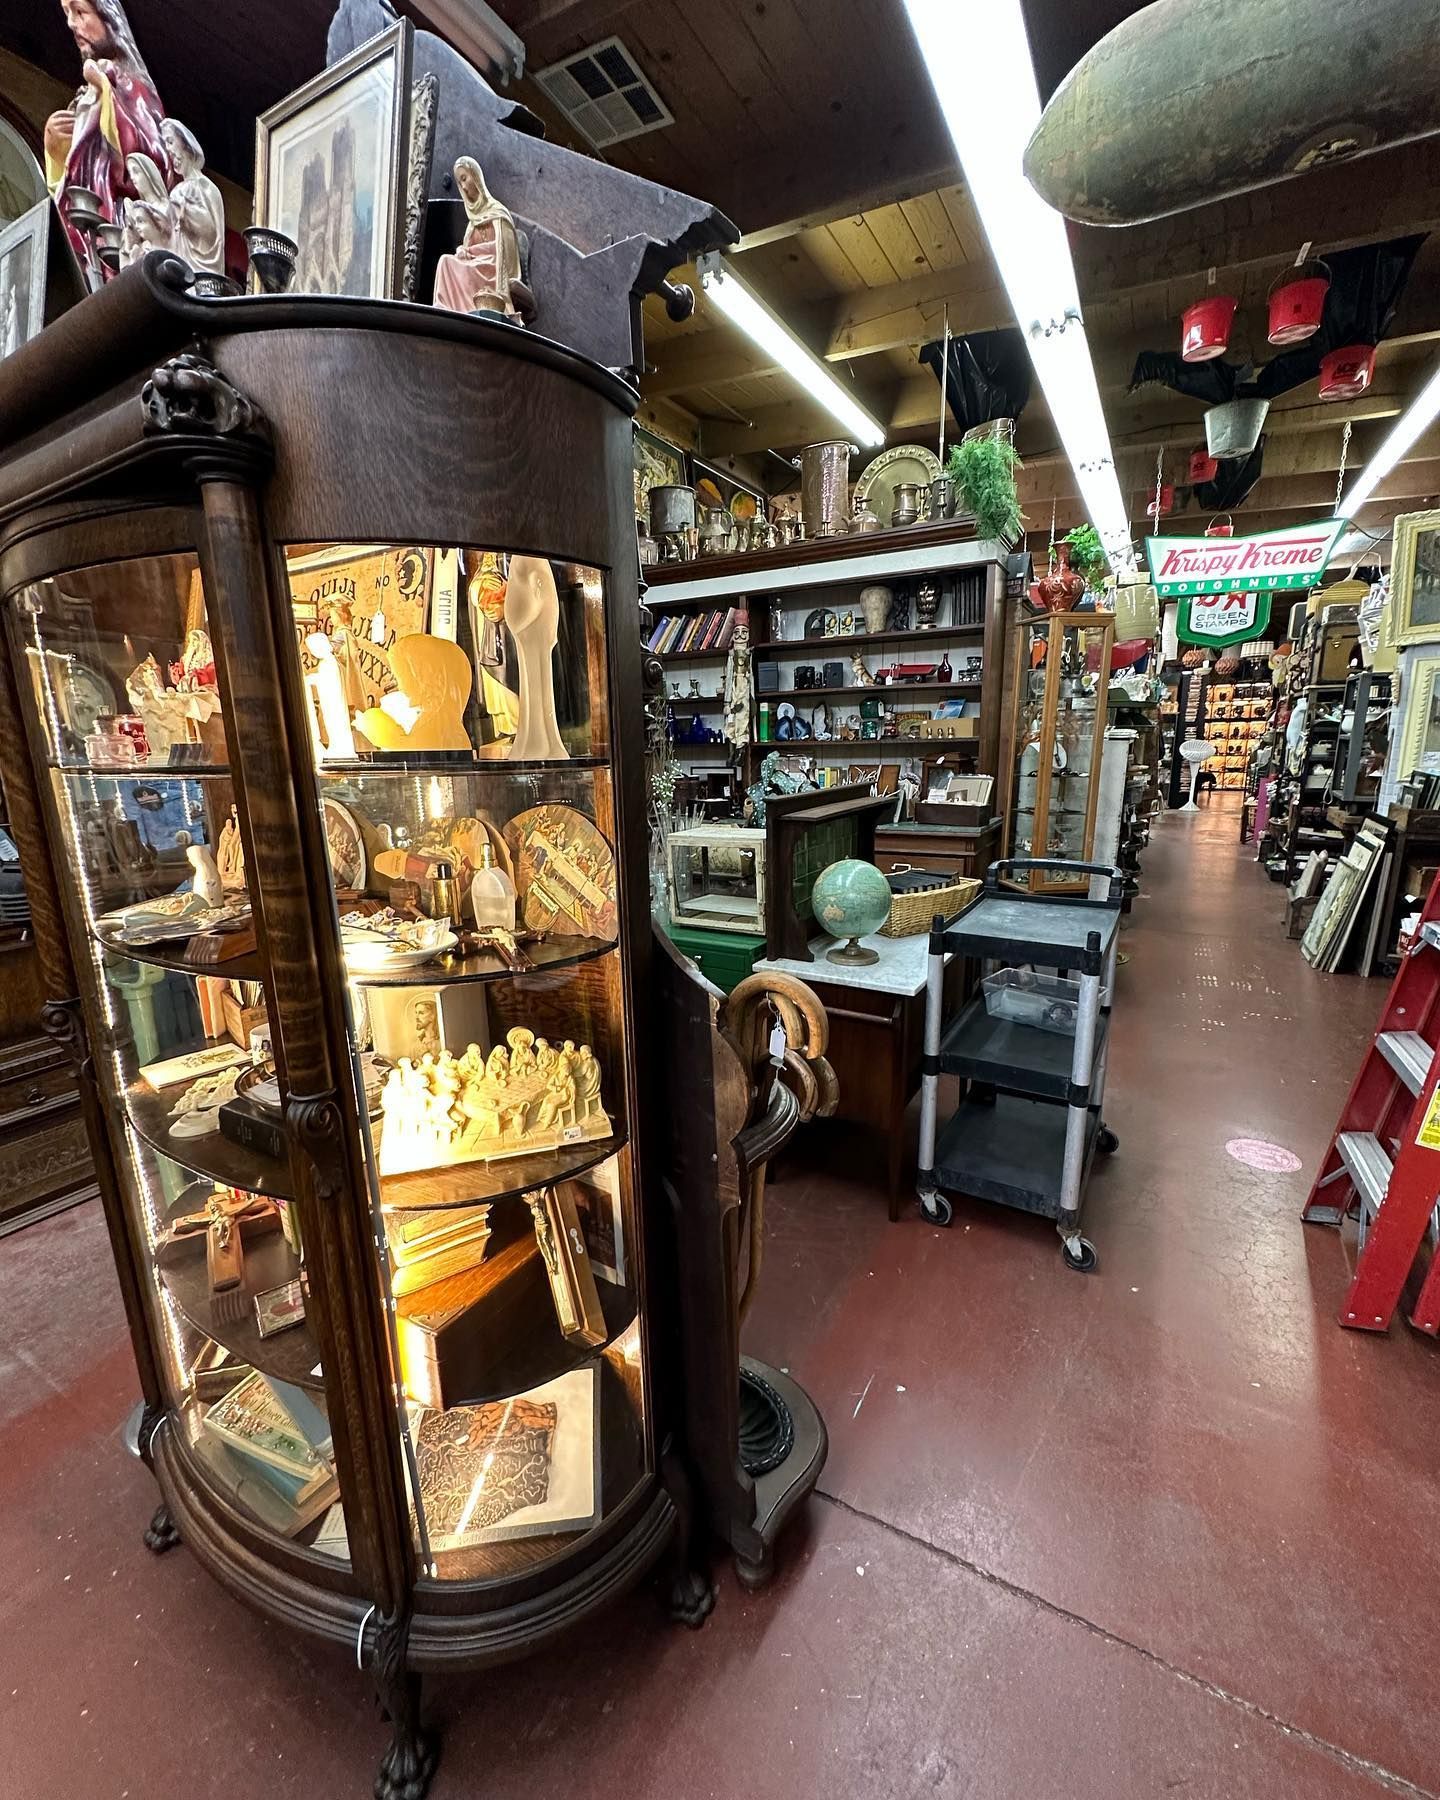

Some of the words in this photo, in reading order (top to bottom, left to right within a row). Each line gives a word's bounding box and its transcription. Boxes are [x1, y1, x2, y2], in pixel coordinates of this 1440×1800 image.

[1158, 544, 1243, 577] Krispy
[1237, 534, 1331, 571] Kreme
[310, 577, 357, 602] OUIJA
[374, 575, 390, 590] NO
[1161, 574, 1316, 594] DOUGHNUTS
[1195, 618, 1248, 629] STAMPS
[1196, 611, 1249, 622] GREEN
